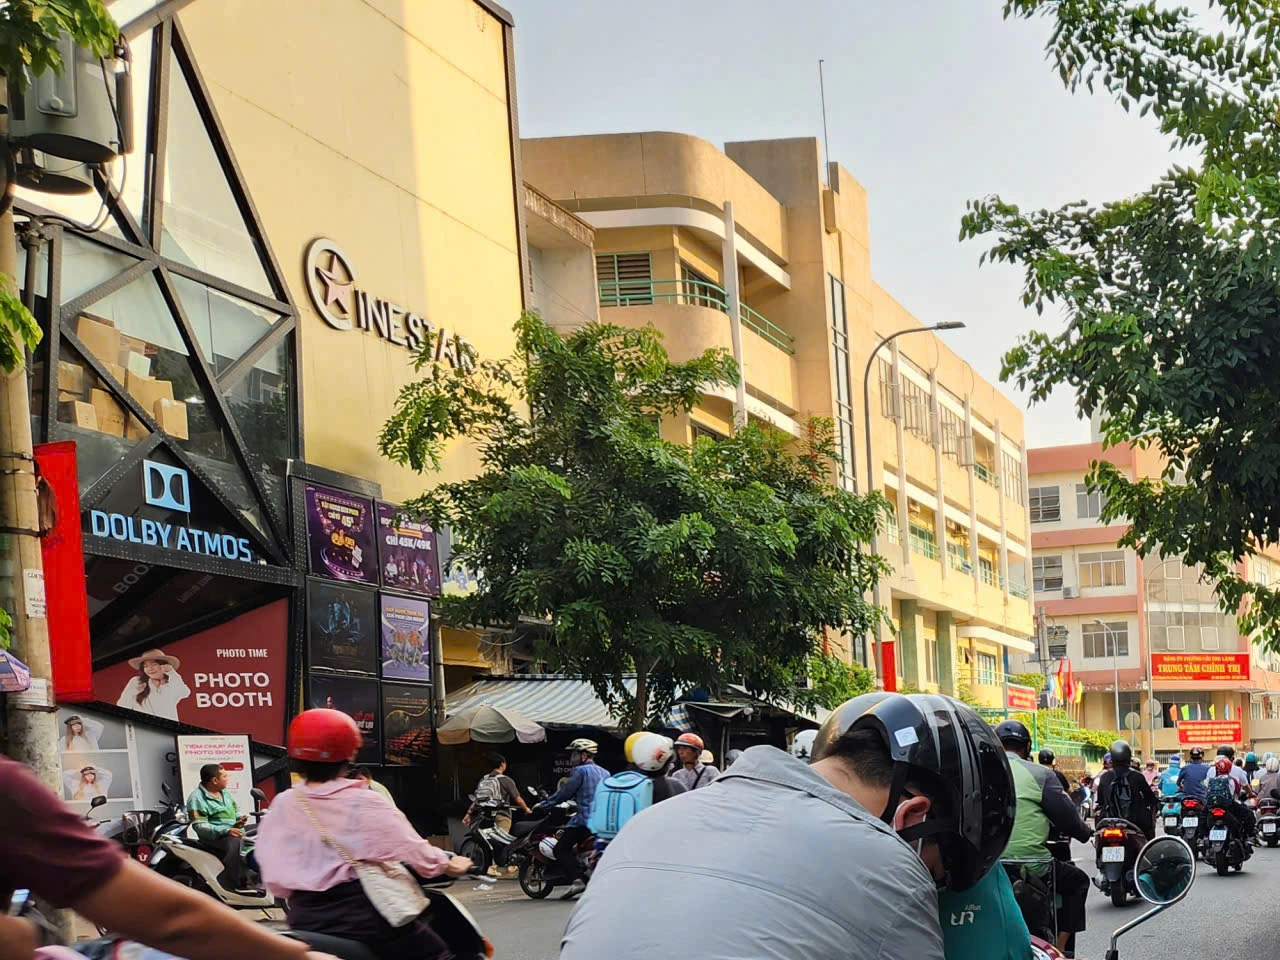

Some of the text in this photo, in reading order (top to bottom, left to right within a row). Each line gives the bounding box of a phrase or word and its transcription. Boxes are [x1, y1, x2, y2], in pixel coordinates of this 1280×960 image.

[91, 509, 252, 563] DOLBY ATMOS
[216, 648, 269, 658] PHOTO TIME
[1158, 664, 1182, 673] TRUNG
[1184, 662, 1200, 673] TÂM
[1202, 662, 1225, 672] CHÍNH
[194, 672, 270, 688] PHOTO
[196, 692, 273, 708] BOOTH
